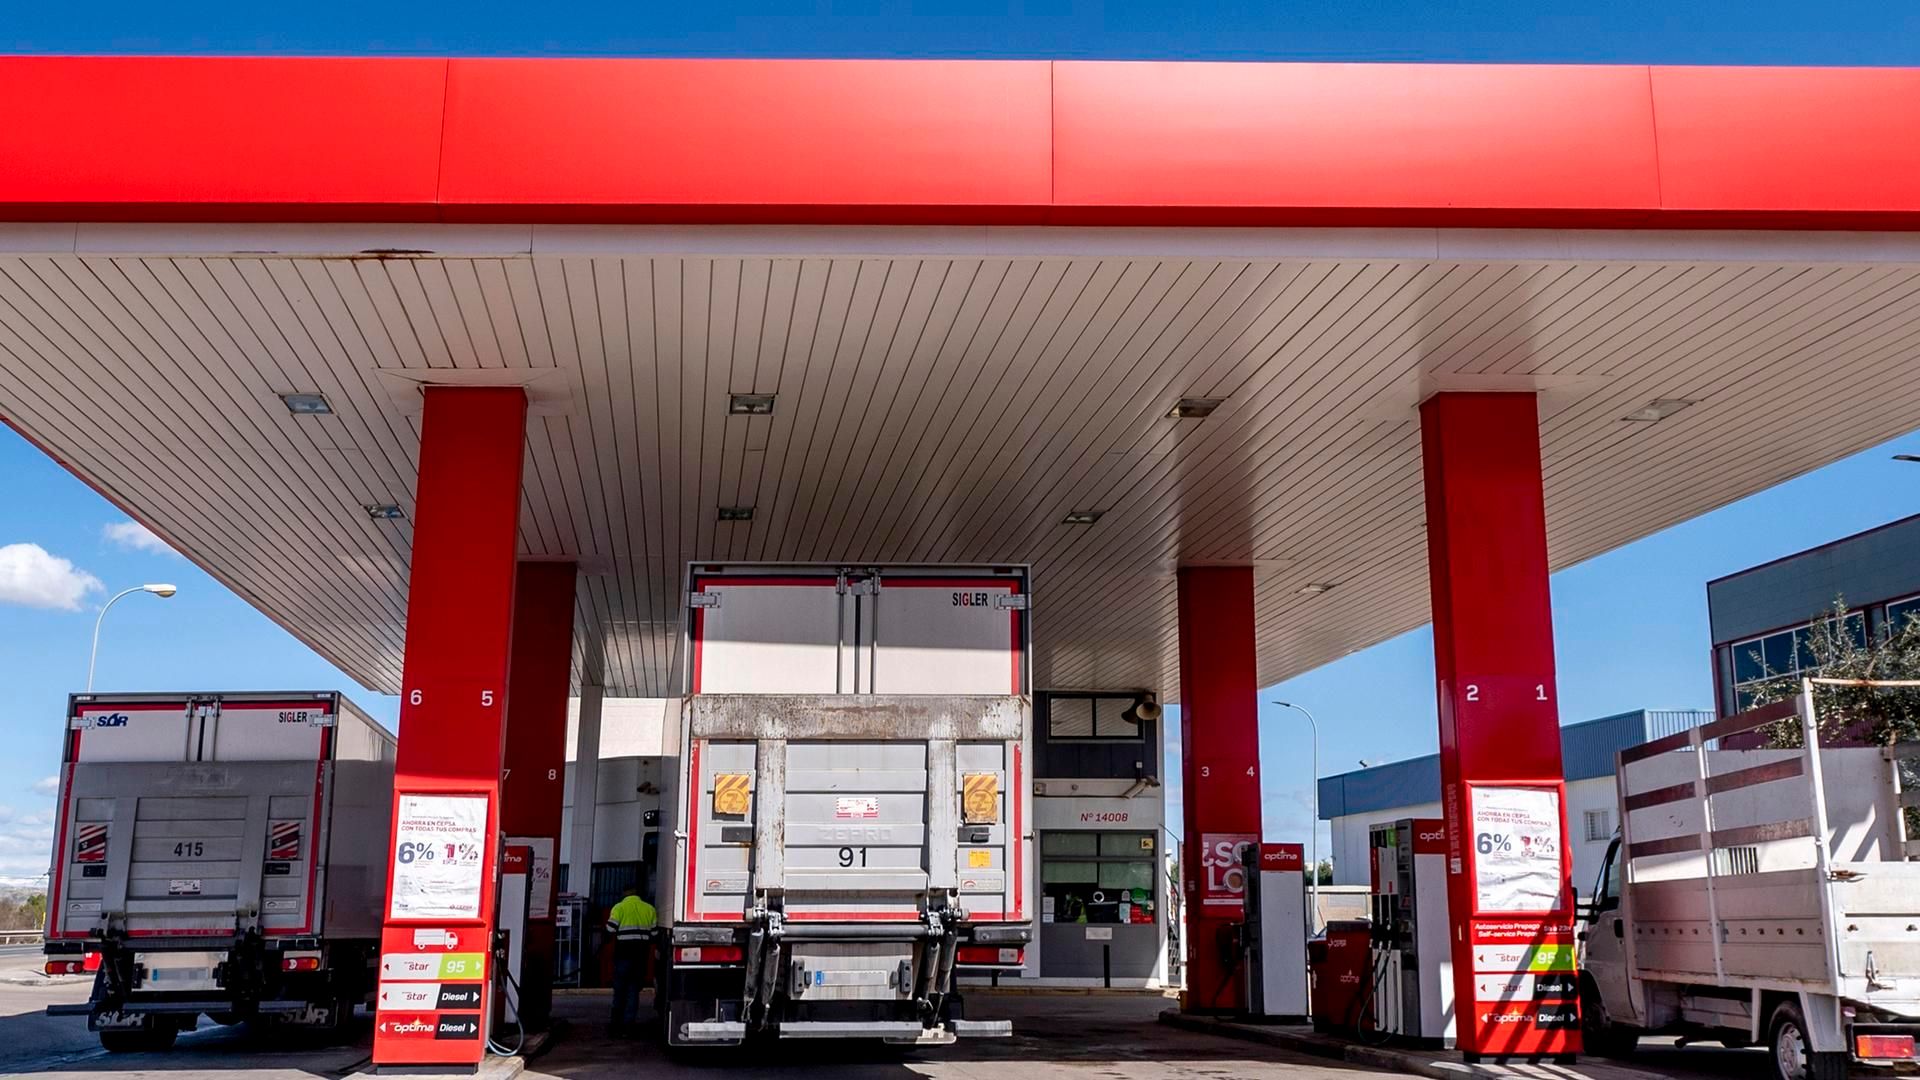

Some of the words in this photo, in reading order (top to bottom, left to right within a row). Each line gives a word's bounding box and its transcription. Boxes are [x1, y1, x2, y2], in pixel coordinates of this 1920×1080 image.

[952, 592, 988, 606] SIGLER
[410, 689, 422, 705] 6
[1466, 684, 1479, 701] 2
[1535, 684, 1548, 700] 1
[481, 690, 493, 706] 5
[279, 711, 307, 723] SIGLER
[502, 769, 511, 780] 7
[547, 769, 557, 780] 8
[1201, 766, 1210, 777] 3
[1246, 766, 1255, 777] 4
[1095, 813, 1128, 822] 14008
[1420, 831, 1445, 842] opti
[174, 841, 203, 857] 415
[1477, 833, 1512, 854] 6%
[398, 842, 434, 864] 6%
[838, 847, 867, 867] 91
[1264, 853, 1297, 861] optima
[1537, 952, 1556, 964] 95
[409, 961, 429, 971] star
[446, 961, 465, 973] 95
[407, 991, 427, 1001] star
[442, 992, 468, 1001] Diesel
[1494, 1013, 1533, 1024] optima
[1539, 1013, 1564, 1022] Diesel
[394, 1023, 434, 1034] optima
[440, 1023, 465, 1032] Diesel
